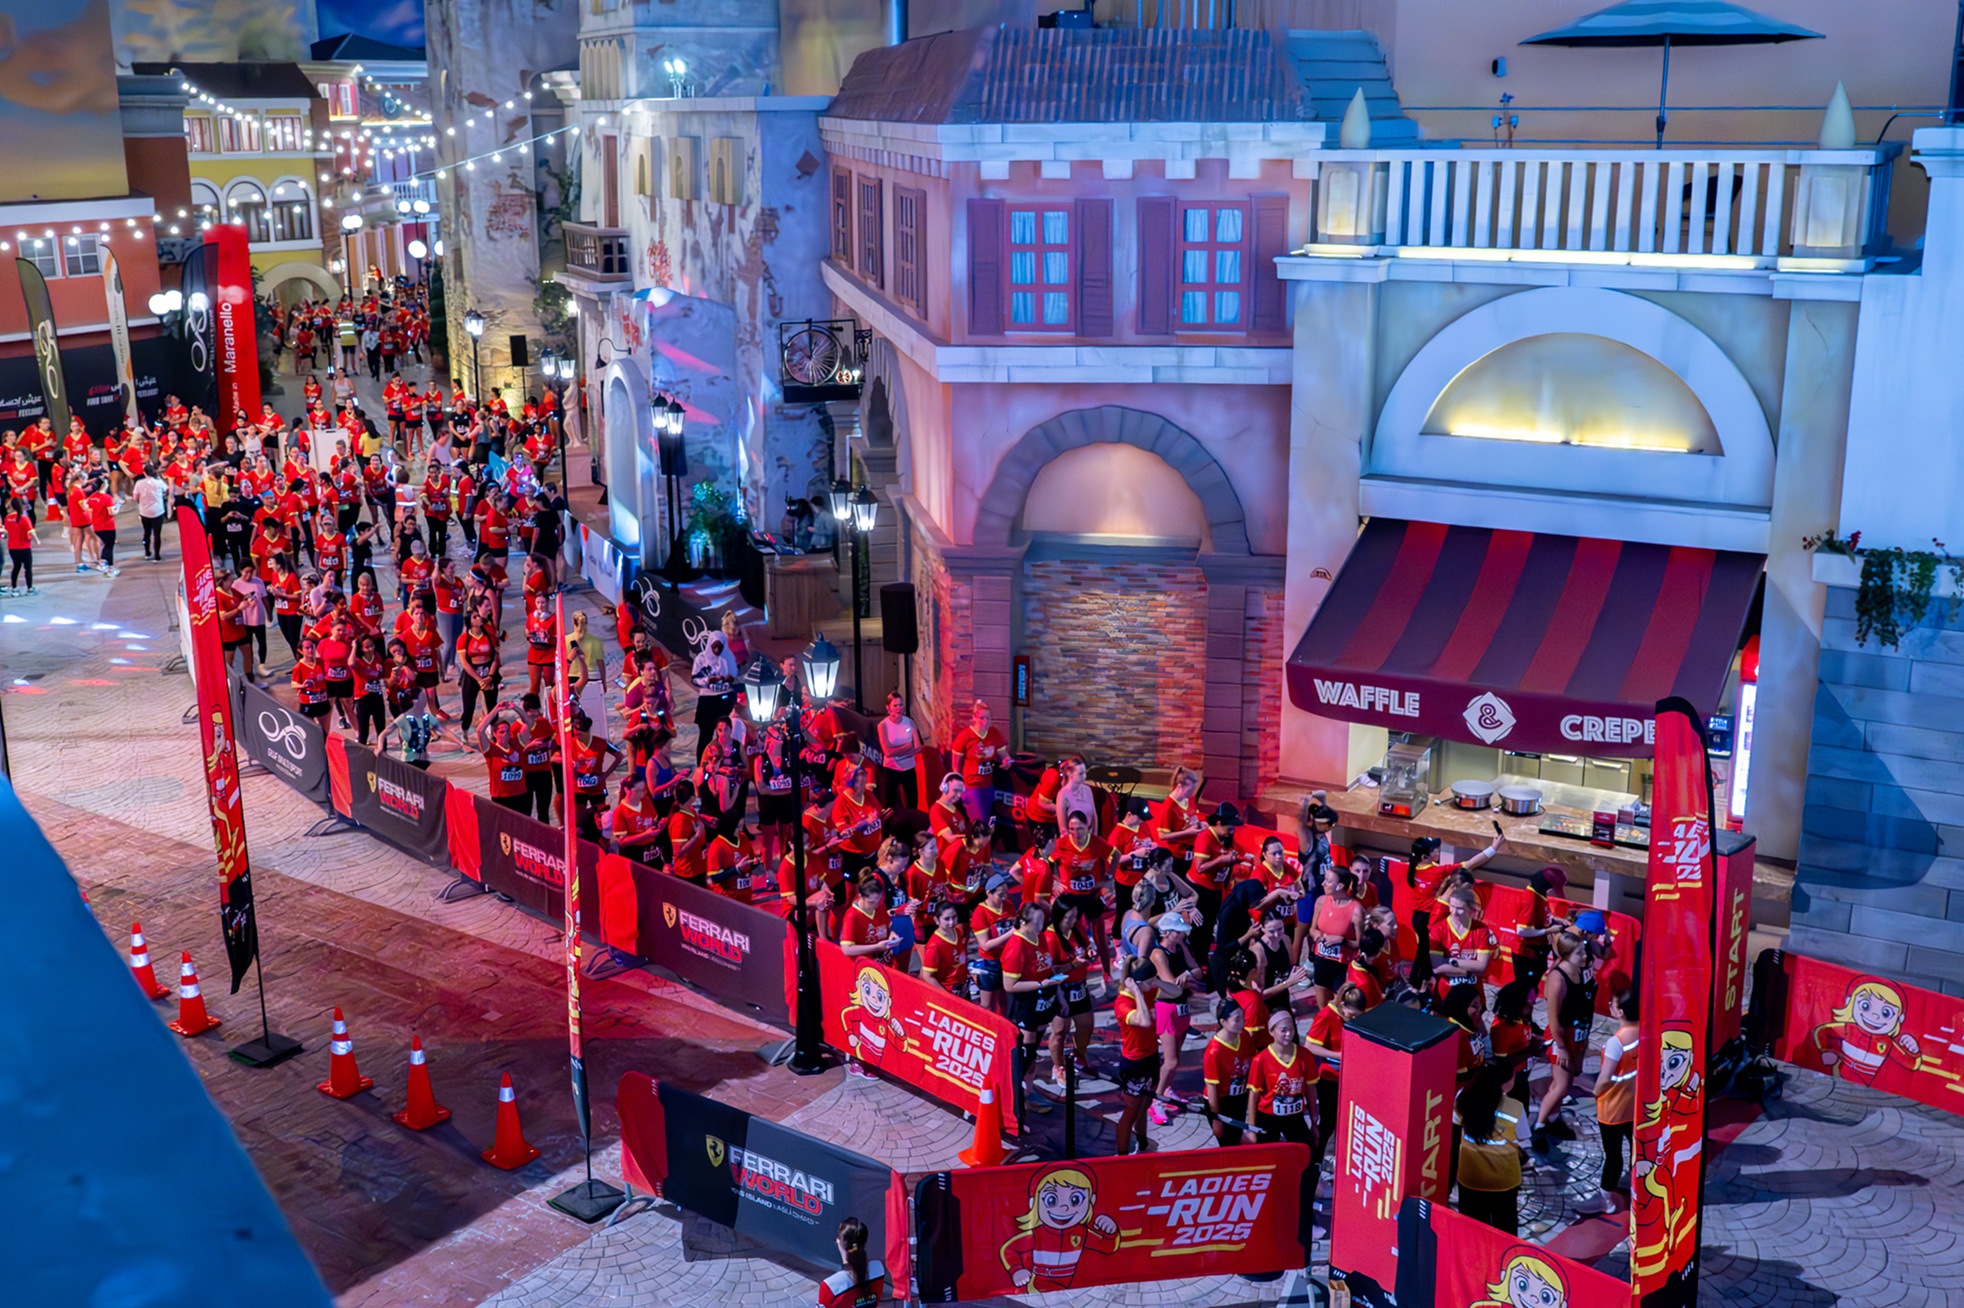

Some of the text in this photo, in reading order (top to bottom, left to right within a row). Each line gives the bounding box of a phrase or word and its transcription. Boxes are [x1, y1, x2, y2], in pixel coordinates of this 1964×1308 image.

[219, 301, 237, 373] Maranello
[1313, 678, 1656, 744] WAFFLE & CREPE
[378, 777, 425, 810] FERRARI
[378, 789, 420, 820] WORLD
[513, 838, 566, 876] FERRAR
[514, 852, 565, 886] WORLD
[679, 909, 750, 954] FERRARI
[680, 923, 743, 963] WORLD
[1725, 887, 1745, 1011] START
[928, 1010, 995, 1052] LADIES
[932, 1029, 993, 1075] RUN
[935, 1055, 985, 1089] 2025
[1275, 1102, 1302, 1115] 1118
[1351, 1104, 1366, 1180] LADIES
[1363, 1113, 1384, 1184] RUN
[1381, 1127, 1396, 1185] 2025
[729, 1145, 833, 1203] FERRARI
[730, 1162, 822, 1216] WORLD
[1160, 1173, 1272, 1198] LADIES
[745, 1192, 773, 1209] ISLAND
[1166, 1193, 1267, 1227] RUN
[1172, 1222, 1254, 1246] 2025
